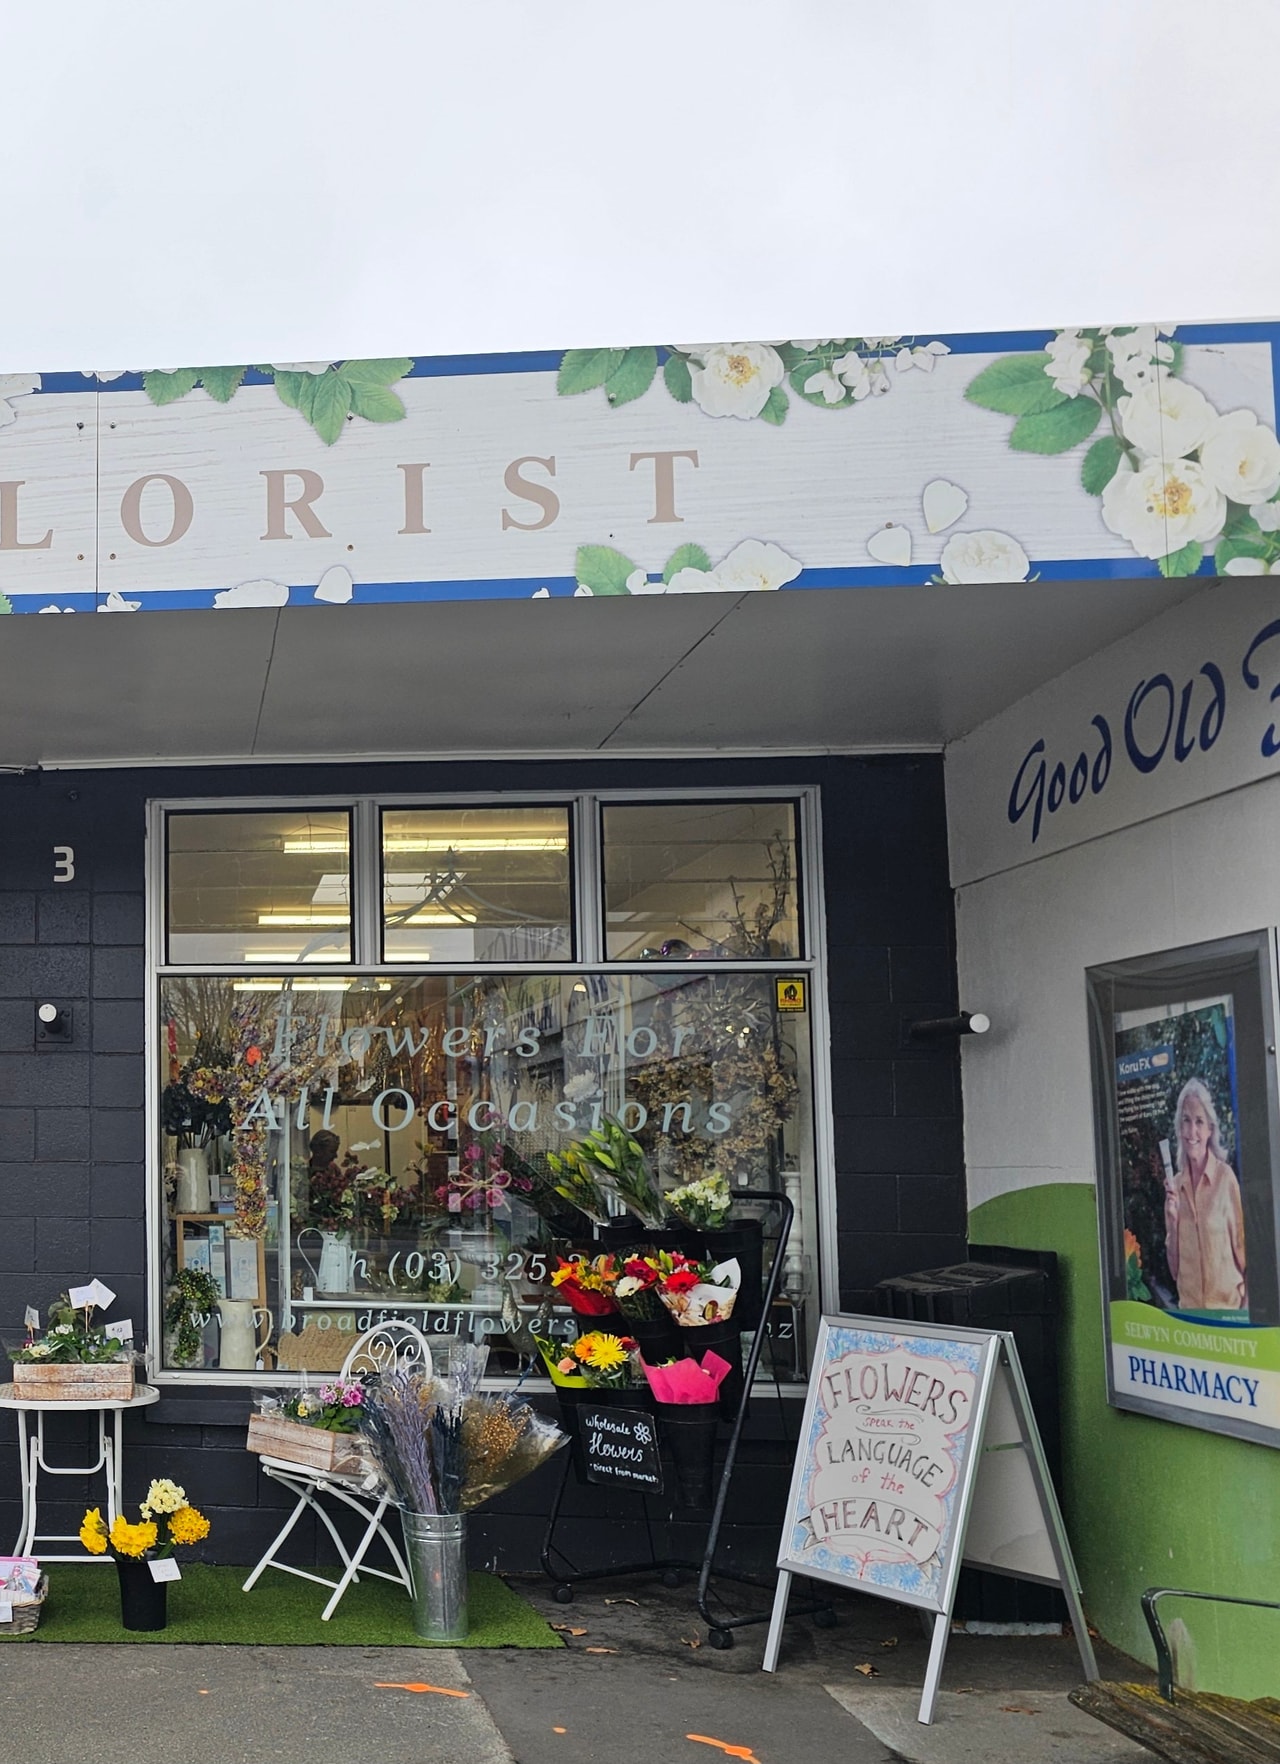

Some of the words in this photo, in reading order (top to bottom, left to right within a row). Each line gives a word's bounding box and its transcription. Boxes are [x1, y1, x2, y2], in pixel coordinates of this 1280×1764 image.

[1008, 714, 1112, 844] Good
[1124, 661, 1226, 774] Old
[53, 846, 75, 882] 3
[273, 1014, 542, 1060] Flowers
[582, 1014, 698, 1060] For
[241, 1086, 335, 1132] All
[372, 1087, 733, 1134] Occasions
[482, 1252, 548, 1282] 325
[1124, 1321, 1170, 1343] SELWYN
[1173, 1329, 1259, 1358] COMMUNITY
[825, 1363, 969, 1425] FLOWERS
[1128, 1355, 1260, 1408] PHARMACY
[826, 1438, 944, 1488] LANGUAGE
[851, 1467, 871, 1483] of
[880, 1472, 905, 1495] the
[820, 1499, 929, 1547] HEART
